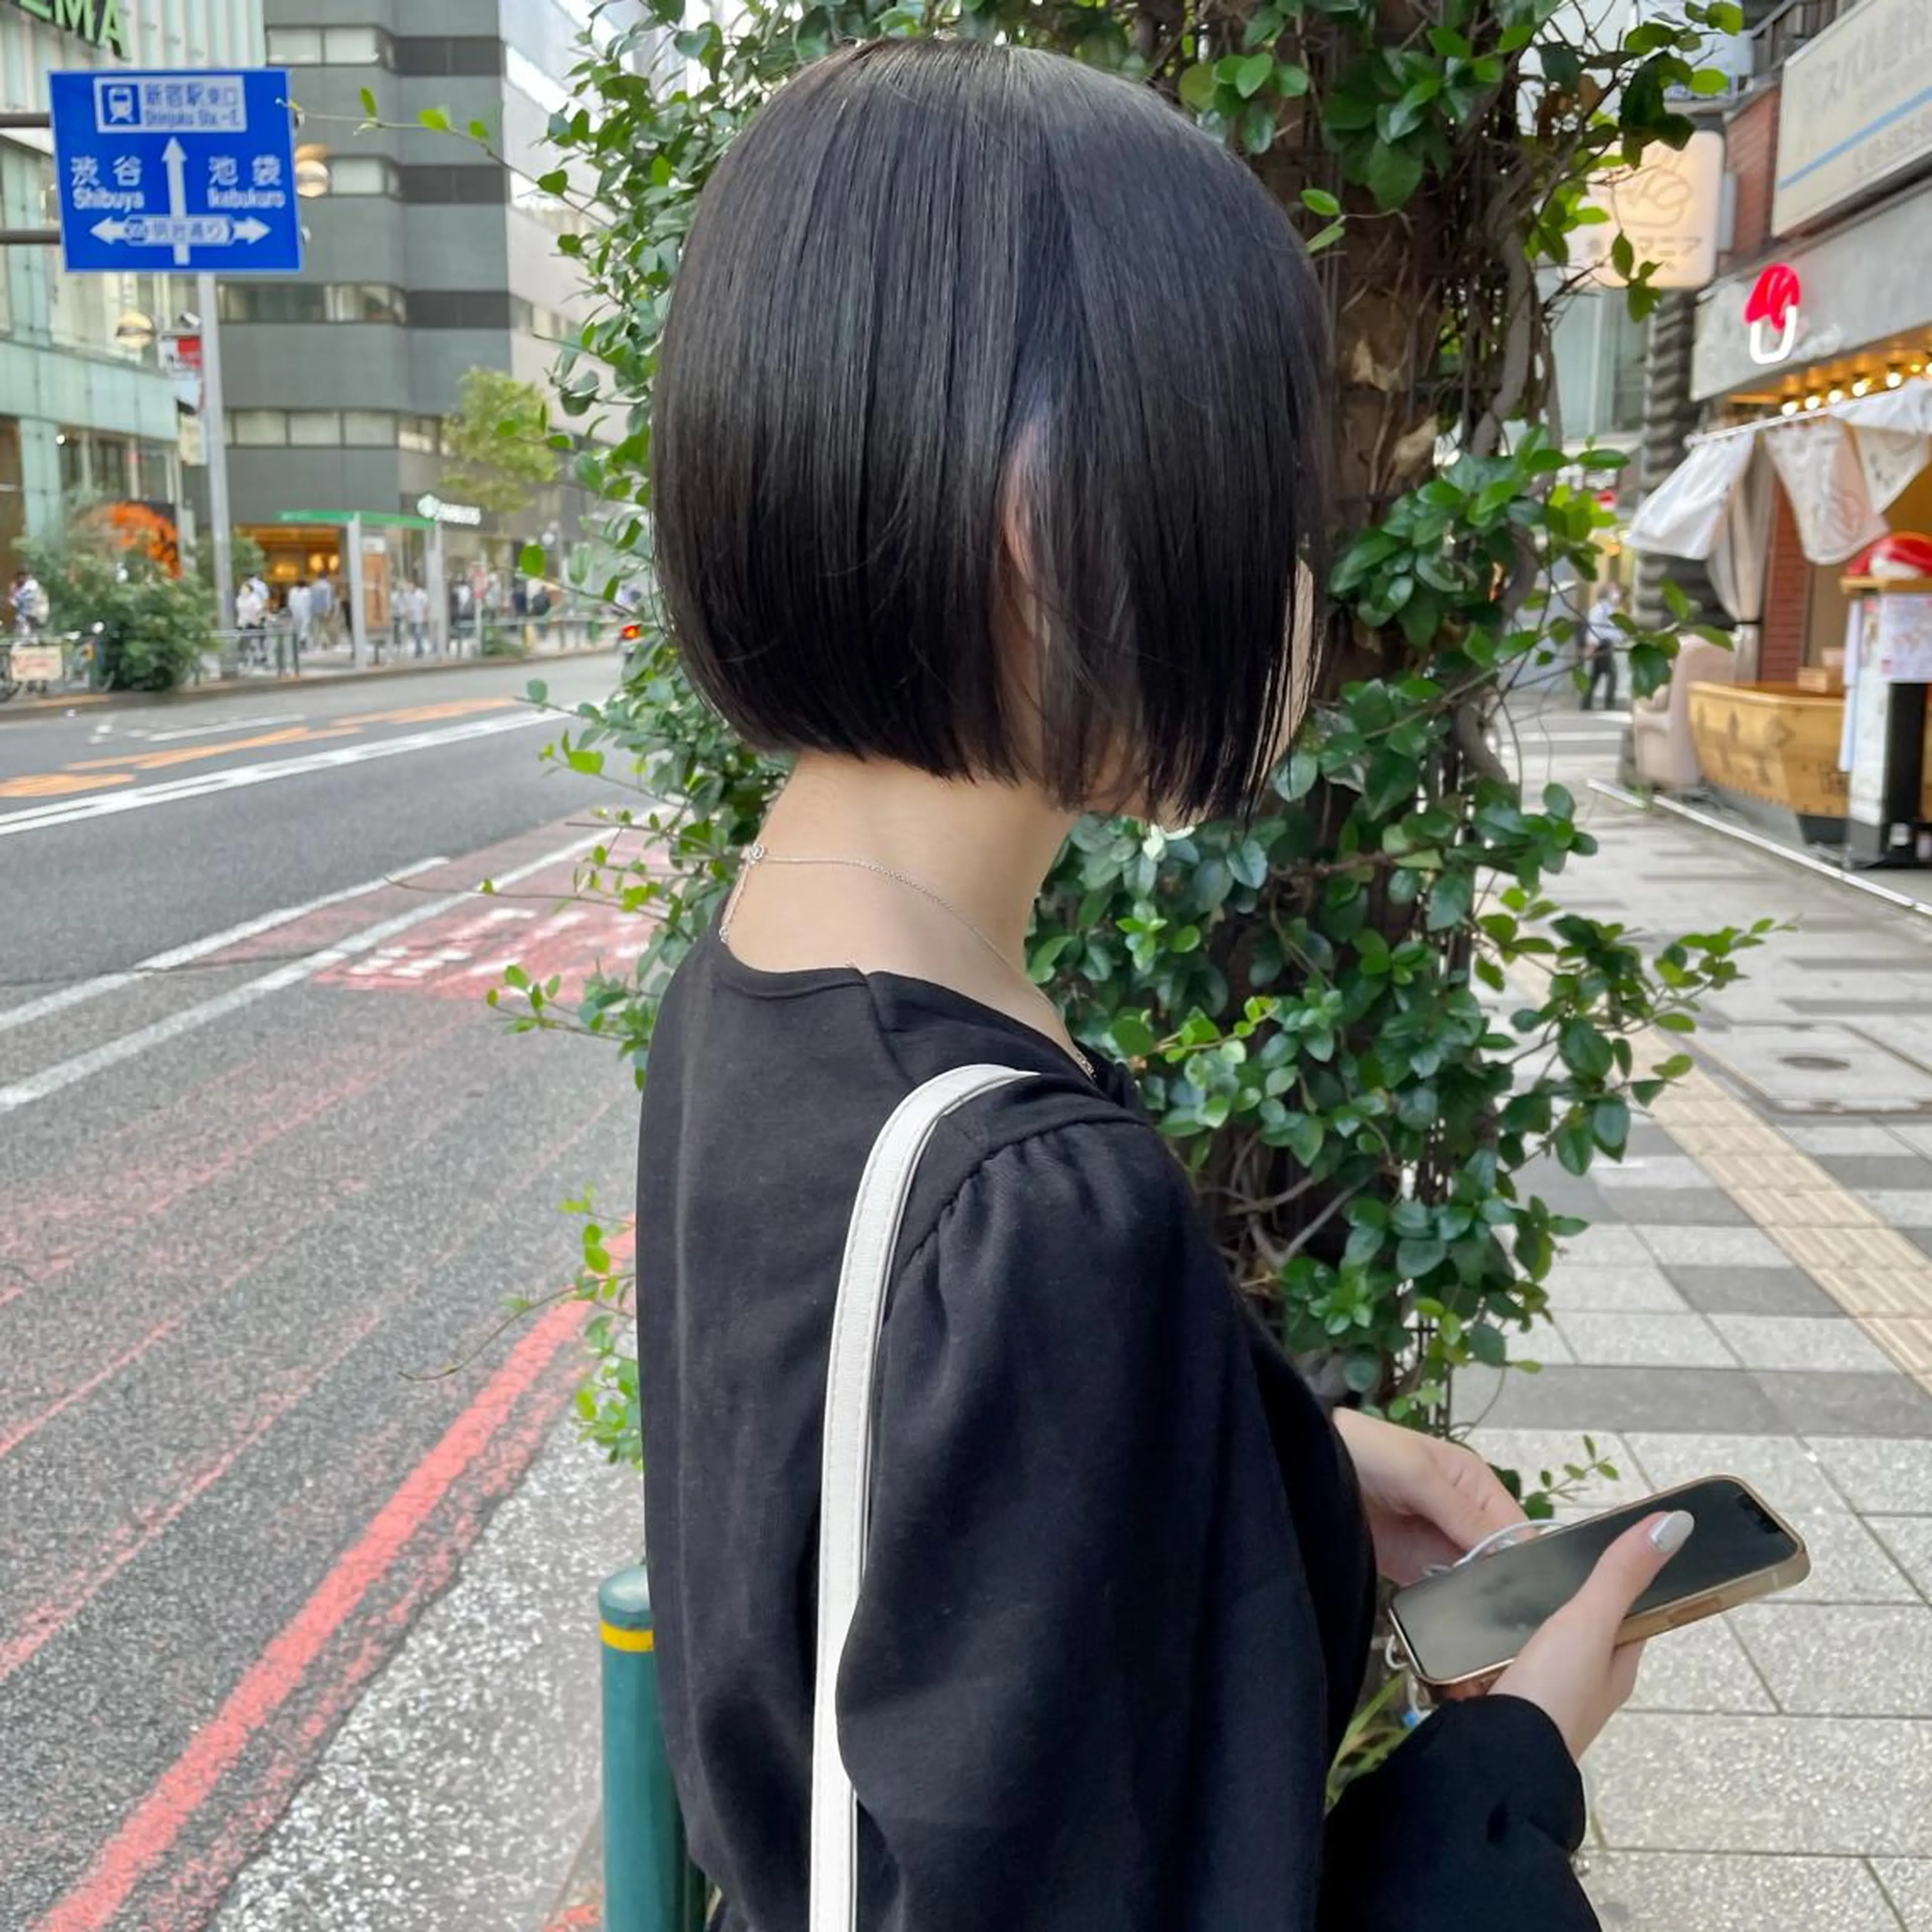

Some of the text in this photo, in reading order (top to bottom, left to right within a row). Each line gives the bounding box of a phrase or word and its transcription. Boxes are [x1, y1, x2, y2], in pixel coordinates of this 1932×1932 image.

[70, 155, 142, 186] 渋谷
[208, 154, 282, 187] 池袋
[72, 186, 145, 213] Shibuya
